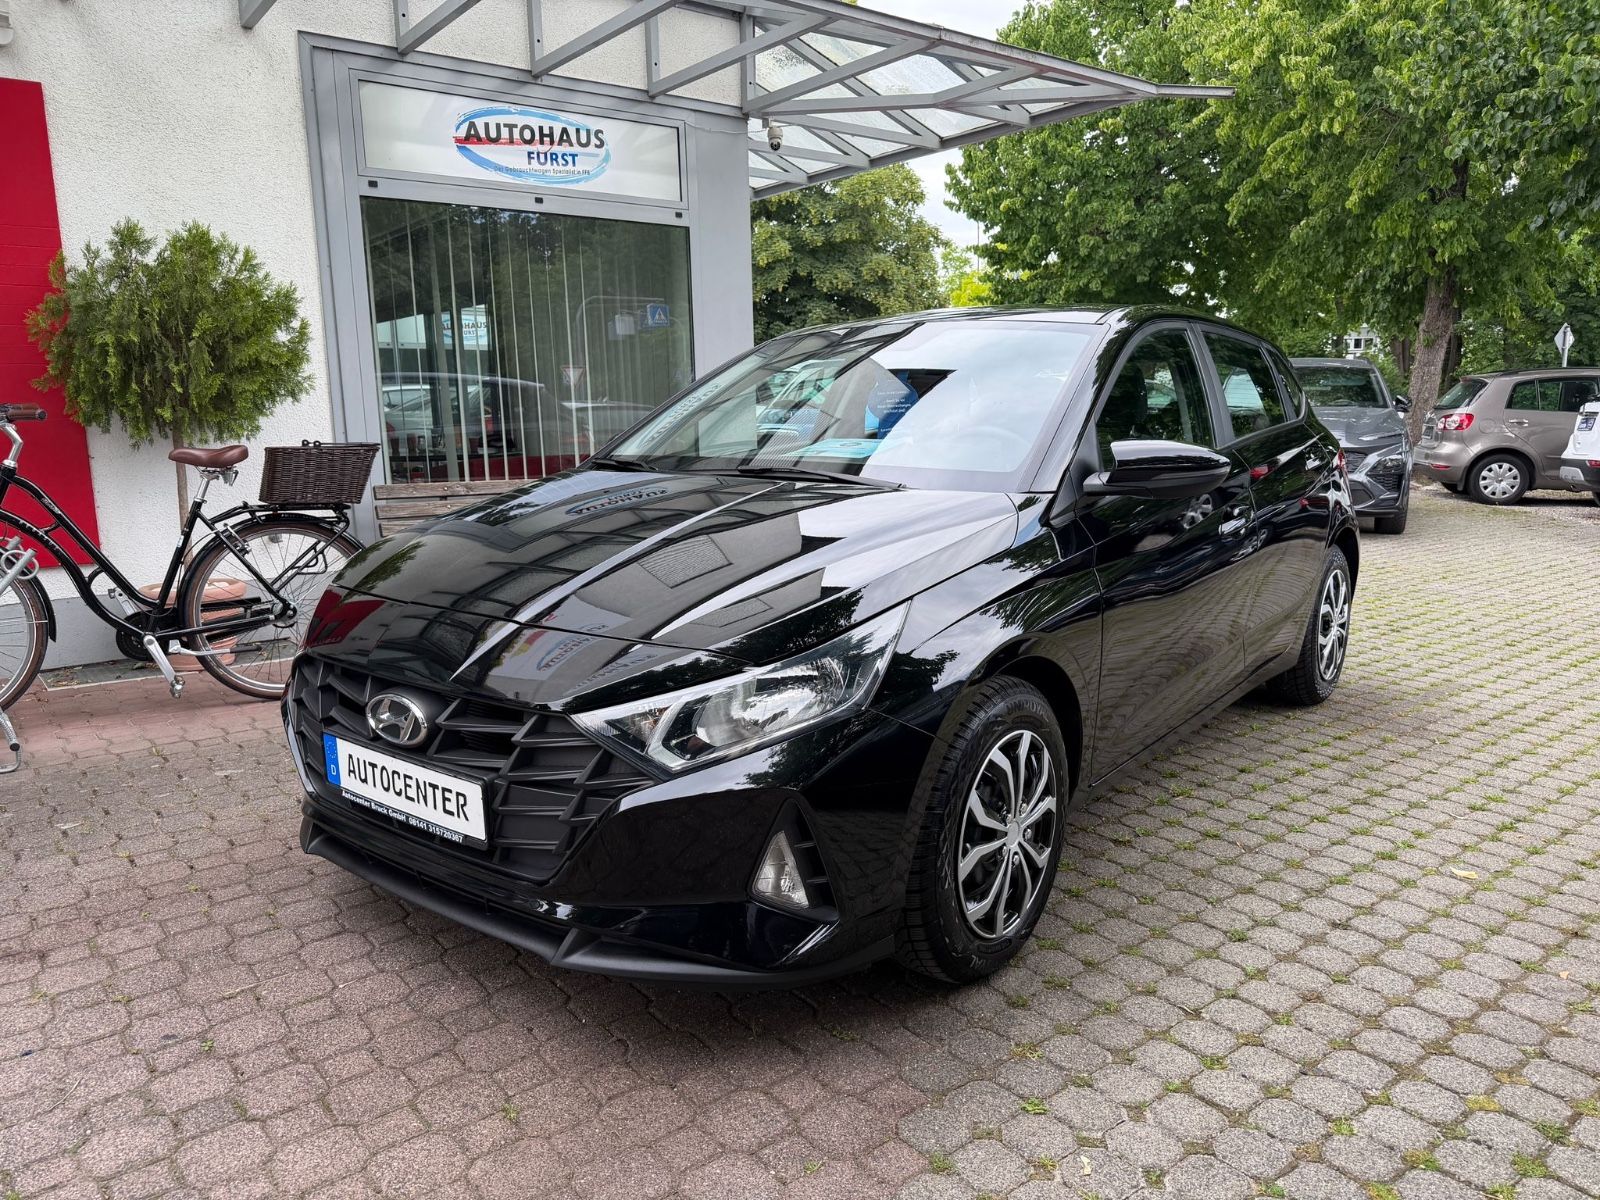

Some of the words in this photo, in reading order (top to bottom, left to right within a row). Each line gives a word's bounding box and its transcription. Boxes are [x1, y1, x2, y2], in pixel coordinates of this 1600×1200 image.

[464, 120, 605, 149] AUTOHAUS
[330, 764, 337, 776] D
[347, 753, 470, 822] AUTOCENTER
[342, 790, 371, 808] Autocenter
[371, 802, 389, 816] Bruck
[388, 809, 407, 823] GmbH
